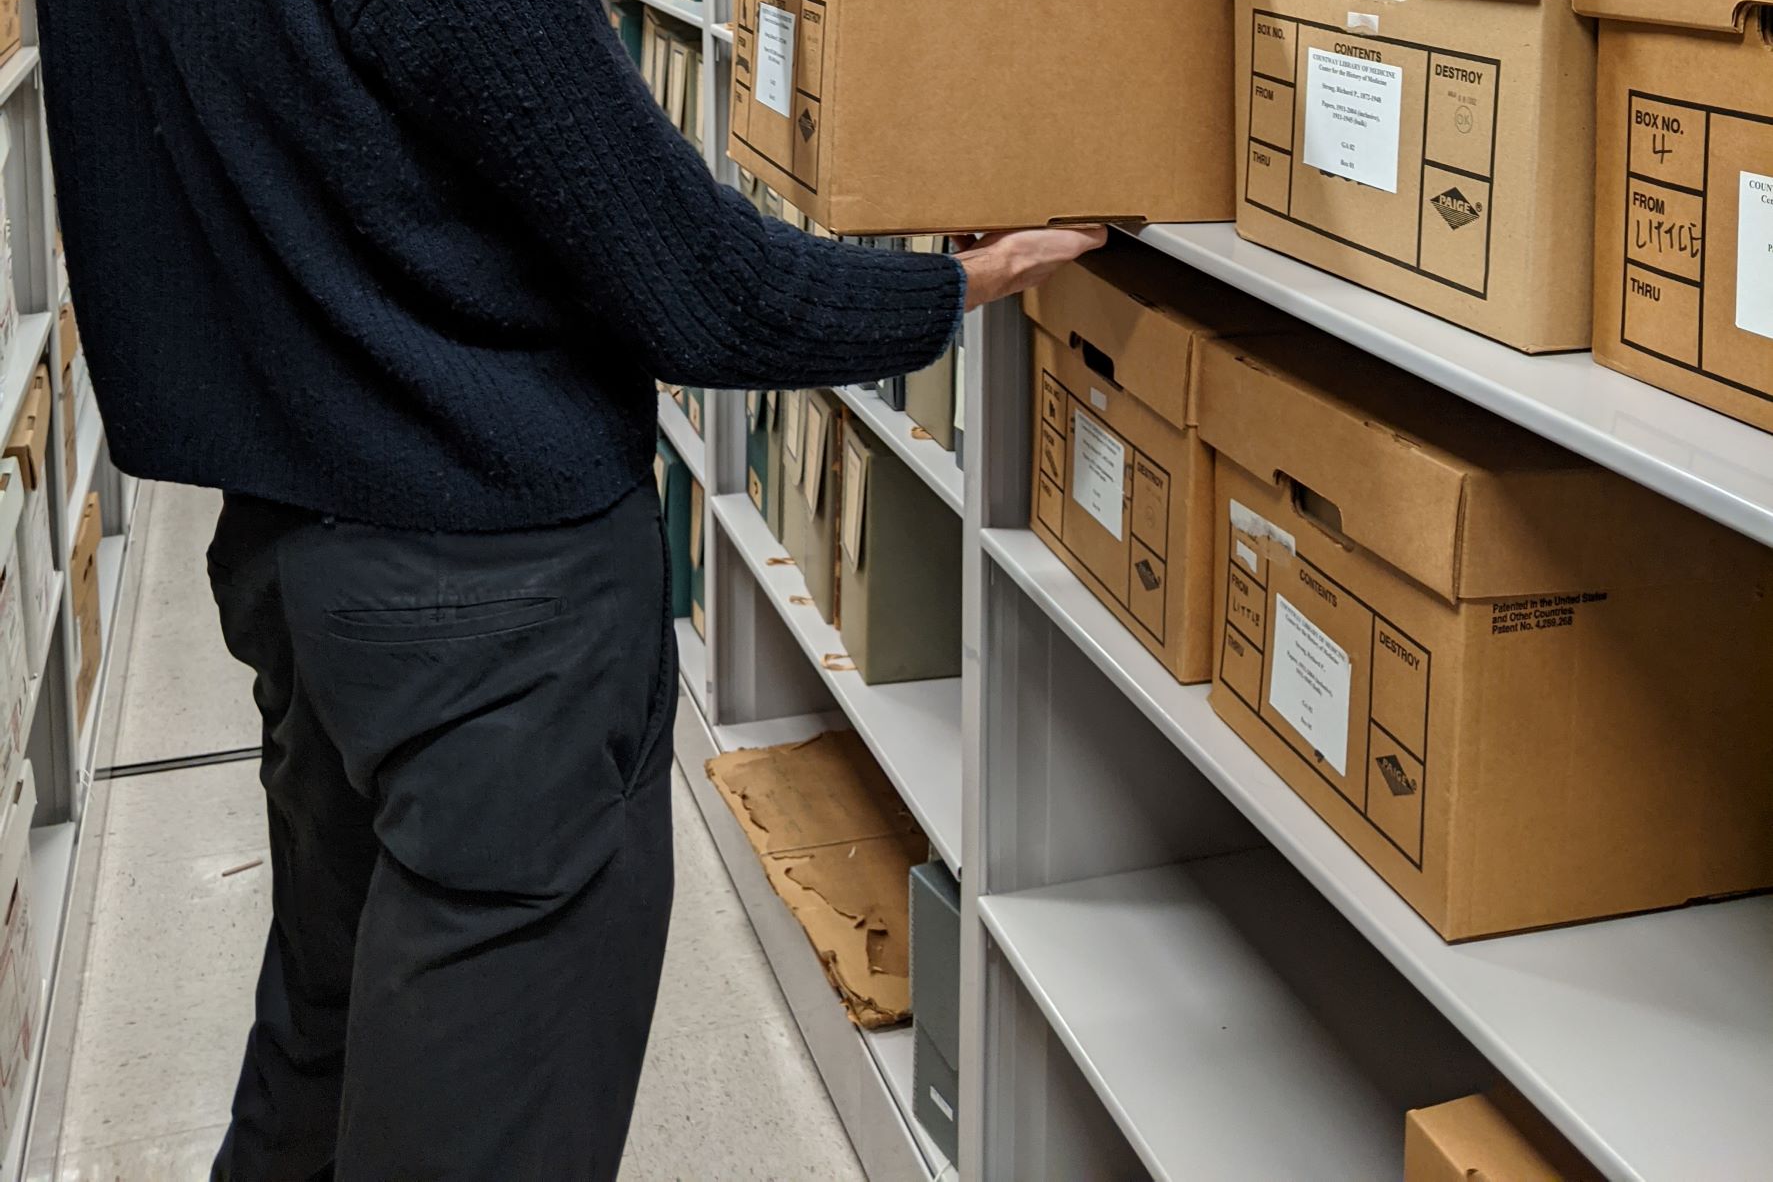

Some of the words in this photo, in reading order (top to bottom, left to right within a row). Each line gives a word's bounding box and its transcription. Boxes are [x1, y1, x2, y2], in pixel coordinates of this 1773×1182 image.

[1257, 23, 1271, 35] BOX
[1272, 26, 1285, 40] NO.
[1334, 43, 1382, 62] CONTENTS
[1340, 60, 1360, 71] LIBRARY
[1370, 67, 1396, 79] MEDICINE
[1435, 63, 1483, 85] DESTROY
[1255, 85, 1274, 101] FROM
[1635, 110, 1659, 128] BOX
[1661, 116, 1684, 135] NO.
[1252, 150, 1271, 167] THRU
[1652, 133, 1673, 164] 4
[1440, 194, 1471, 216] PAIGE
[1632, 191, 1665, 215] FROM
[1630, 277, 1661, 301] THRU
[1231, 573, 1249, 597] FROM
[1299, 569, 1337, 608] CONTENTS
[1492, 600, 1528, 614] Patented
[1530, 600, 1538, 609] in
[1540, 598, 1553, 608] the
[1554, 594, 1580, 606] United
[1492, 614, 1507, 624] and
[1509, 611, 1532, 622] Other
[1492, 622, 1518, 635] Patent
[1520, 621, 1534, 631] No.
[1379, 630, 1420, 671] DESTROY
